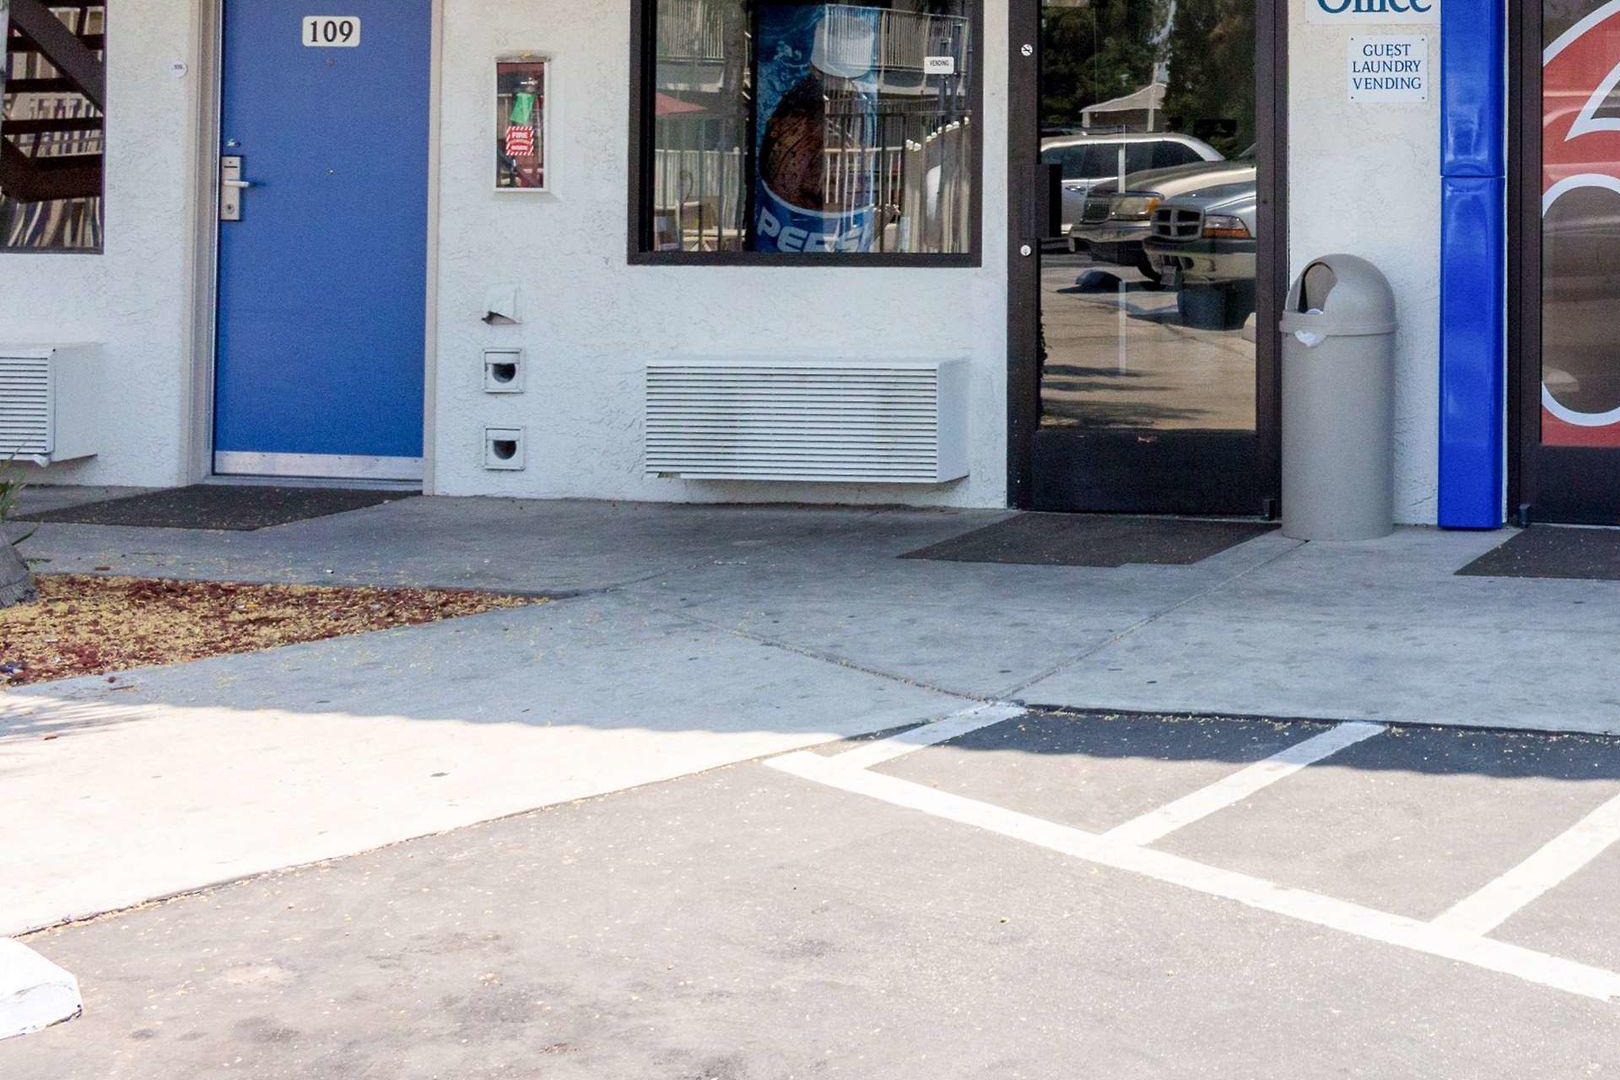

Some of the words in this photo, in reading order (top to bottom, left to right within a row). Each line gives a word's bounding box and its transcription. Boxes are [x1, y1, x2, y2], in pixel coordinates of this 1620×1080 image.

[310, 20, 354, 43] 109
[1362, 43, 1412, 57] GUEST
[1352, 60, 1421, 73] LAUNDRY
[1352, 77, 1421, 90] VENDING
